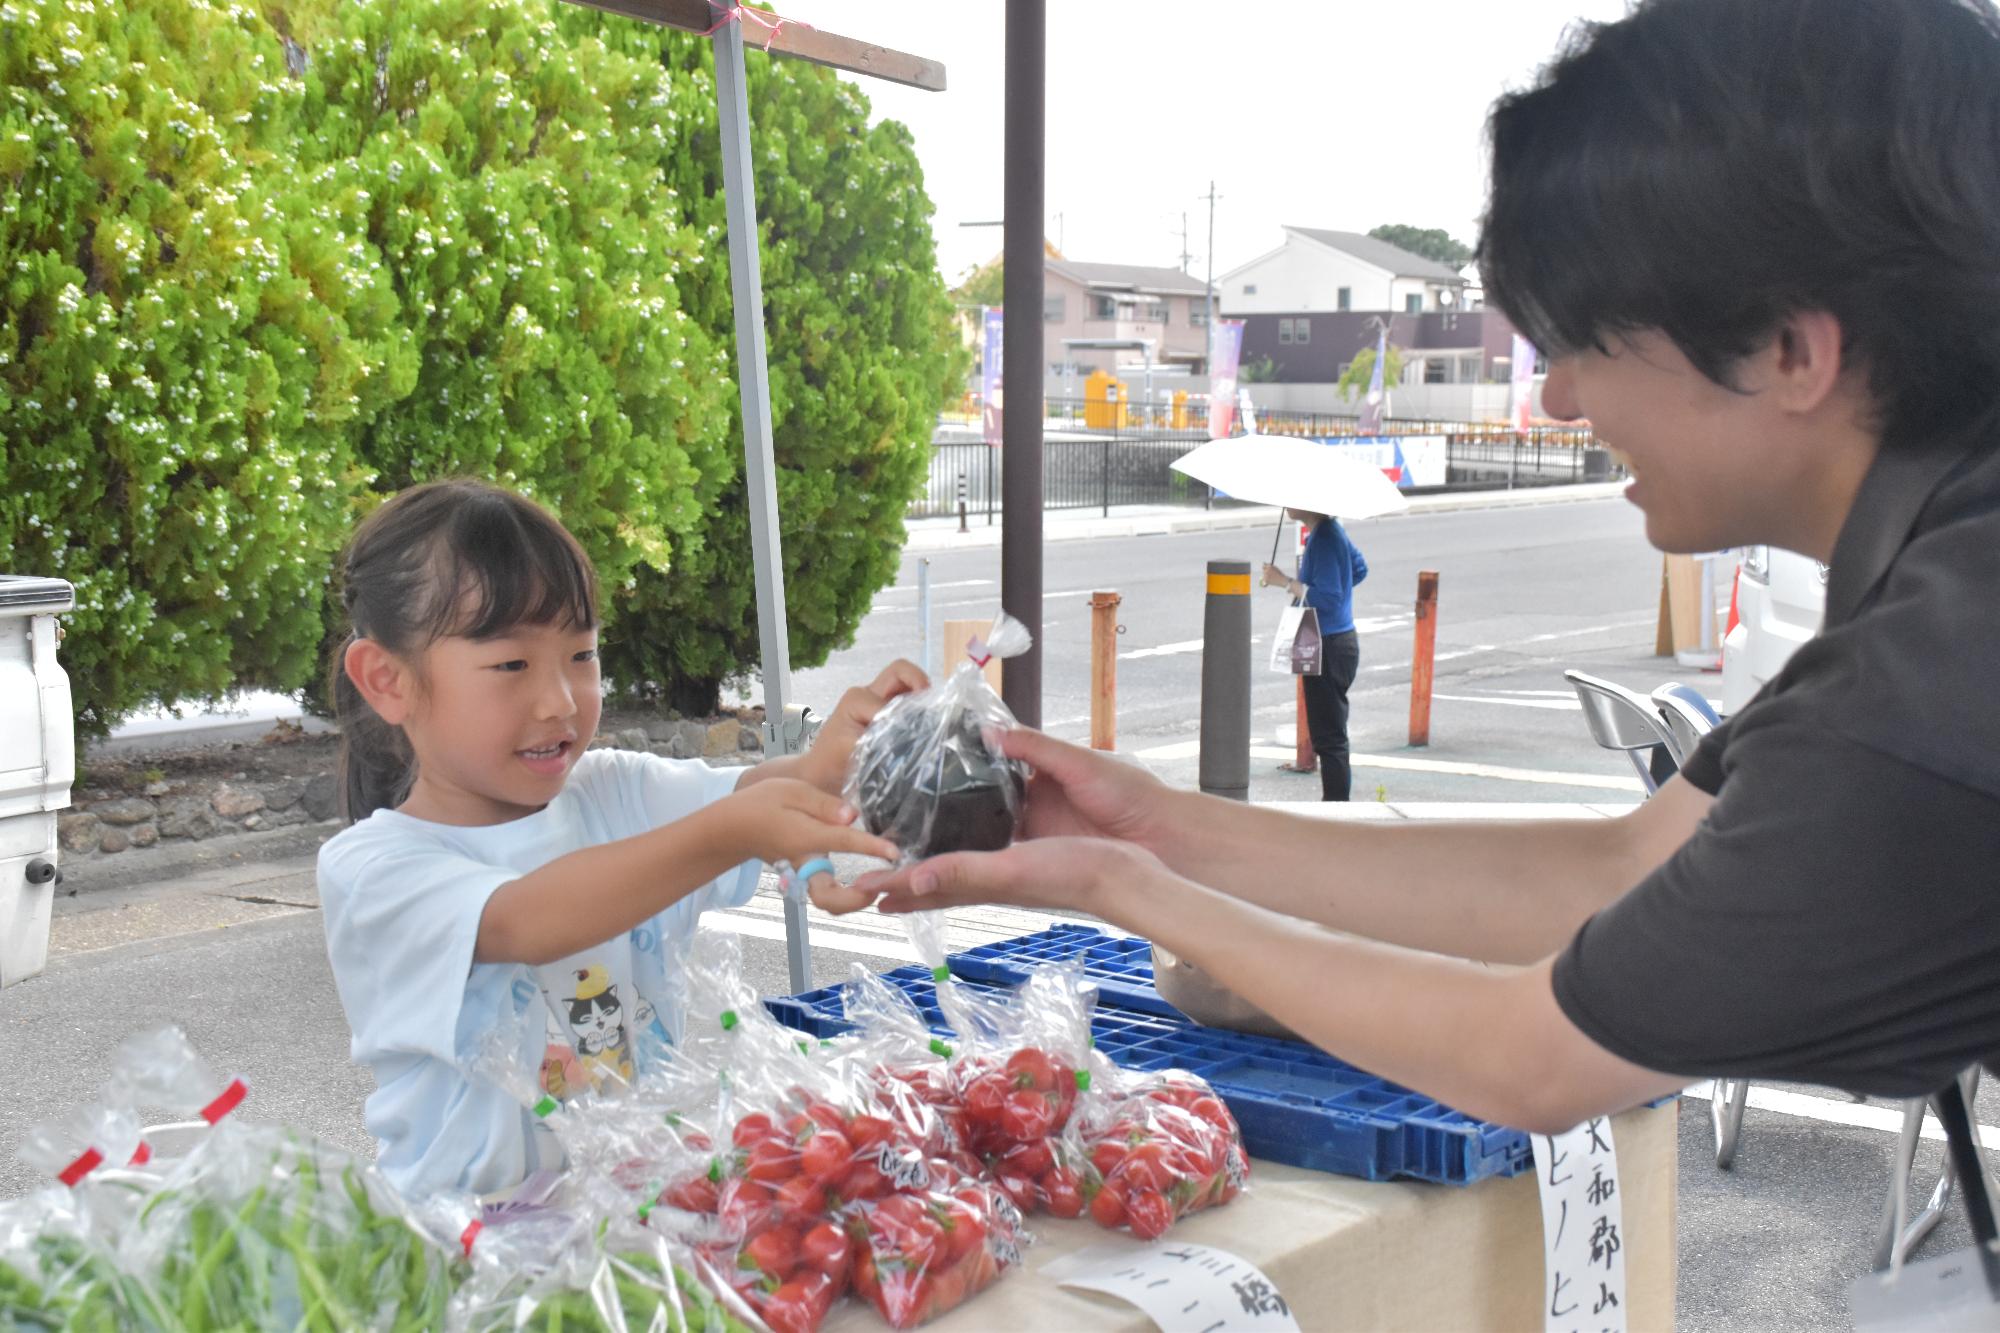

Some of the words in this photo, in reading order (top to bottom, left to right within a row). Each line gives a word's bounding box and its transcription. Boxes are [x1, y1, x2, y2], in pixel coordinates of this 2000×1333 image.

[1546, 1136, 1579, 1333] ヒノヒ
[1585, 1118, 1620, 1333] 大和郡山
